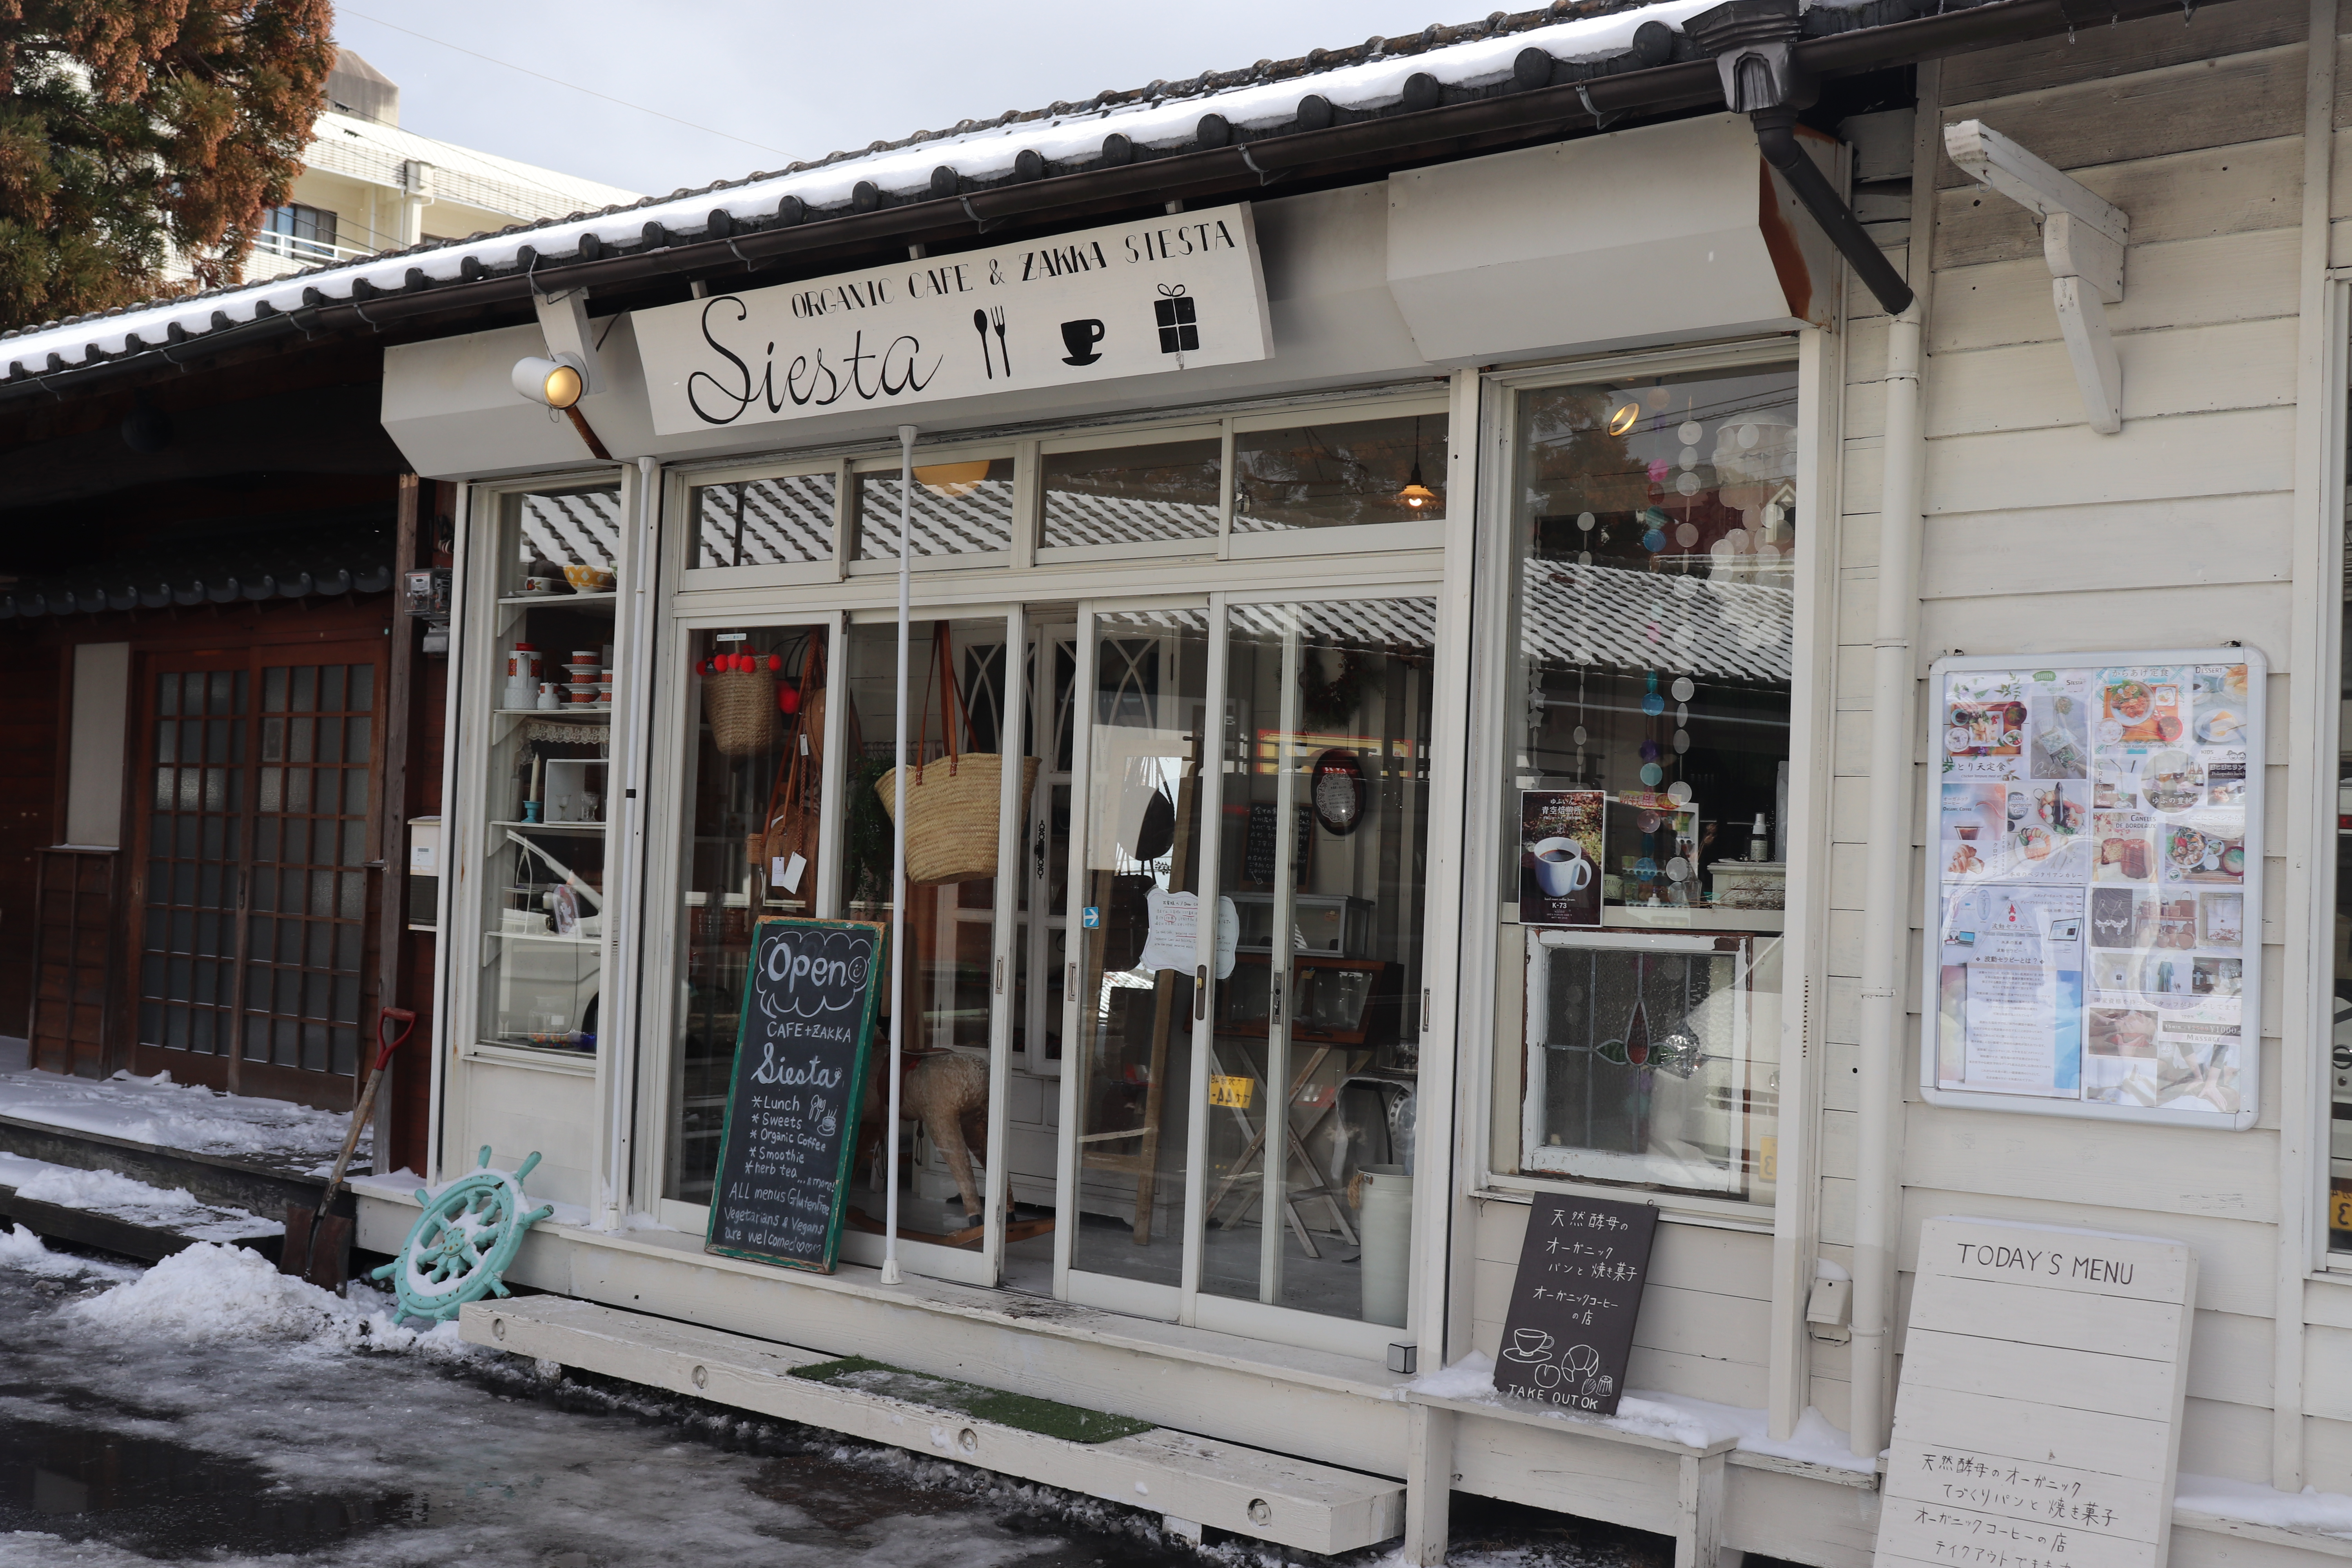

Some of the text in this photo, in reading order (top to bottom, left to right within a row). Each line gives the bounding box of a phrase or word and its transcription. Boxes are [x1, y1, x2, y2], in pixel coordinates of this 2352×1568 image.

[792, 220, 1236, 319] ORGANIC CAFE & ZAKKA SIESTA
[688, 296, 943, 425] Siesta
[2112, 668, 2169, 677] からあげ定食
[1958, 762, 2006, 771] とり天定食
[1542, 806, 1582, 815] 青空焙煎所
[768, 942, 848, 993] Open
[751, 1042, 840, 1089] Siesta
[764, 1095, 800, 1111] Lunch
[762, 1112, 802, 1130] Sweets
[760, 1128, 826, 1152] Organic Coffee
[759, 1146, 804, 1164] Smoothie
[755, 1162, 797, 1178] herb tea
[729, 1182, 750, 1201] ALL
[724, 1207, 824, 1235] Vegetarians & Vegans
[1551, 1209, 1628, 1231] 天然酵母の
[725, 1227, 796, 1251] are welcomed
[1546, 1237, 1613, 1259] オーガニック
[1548, 1262, 1638, 1282] パンと焼き菓子
[1957, 1243, 2133, 1286] TODAY'S MENU
[1533, 1285, 1619, 1308] オーガニックコーヒー
[1572, 1310, 1593, 1325] の店
[1508, 1384, 1598, 1410] TAKE OUT OK
[1922, 1454, 2081, 1499] 天然酵母のオーガニック
[1943, 1484, 2119, 1527] てづくりパンと焼き菓子
[1914, 1506, 2067, 1553] オーガニックコーヒーの店
